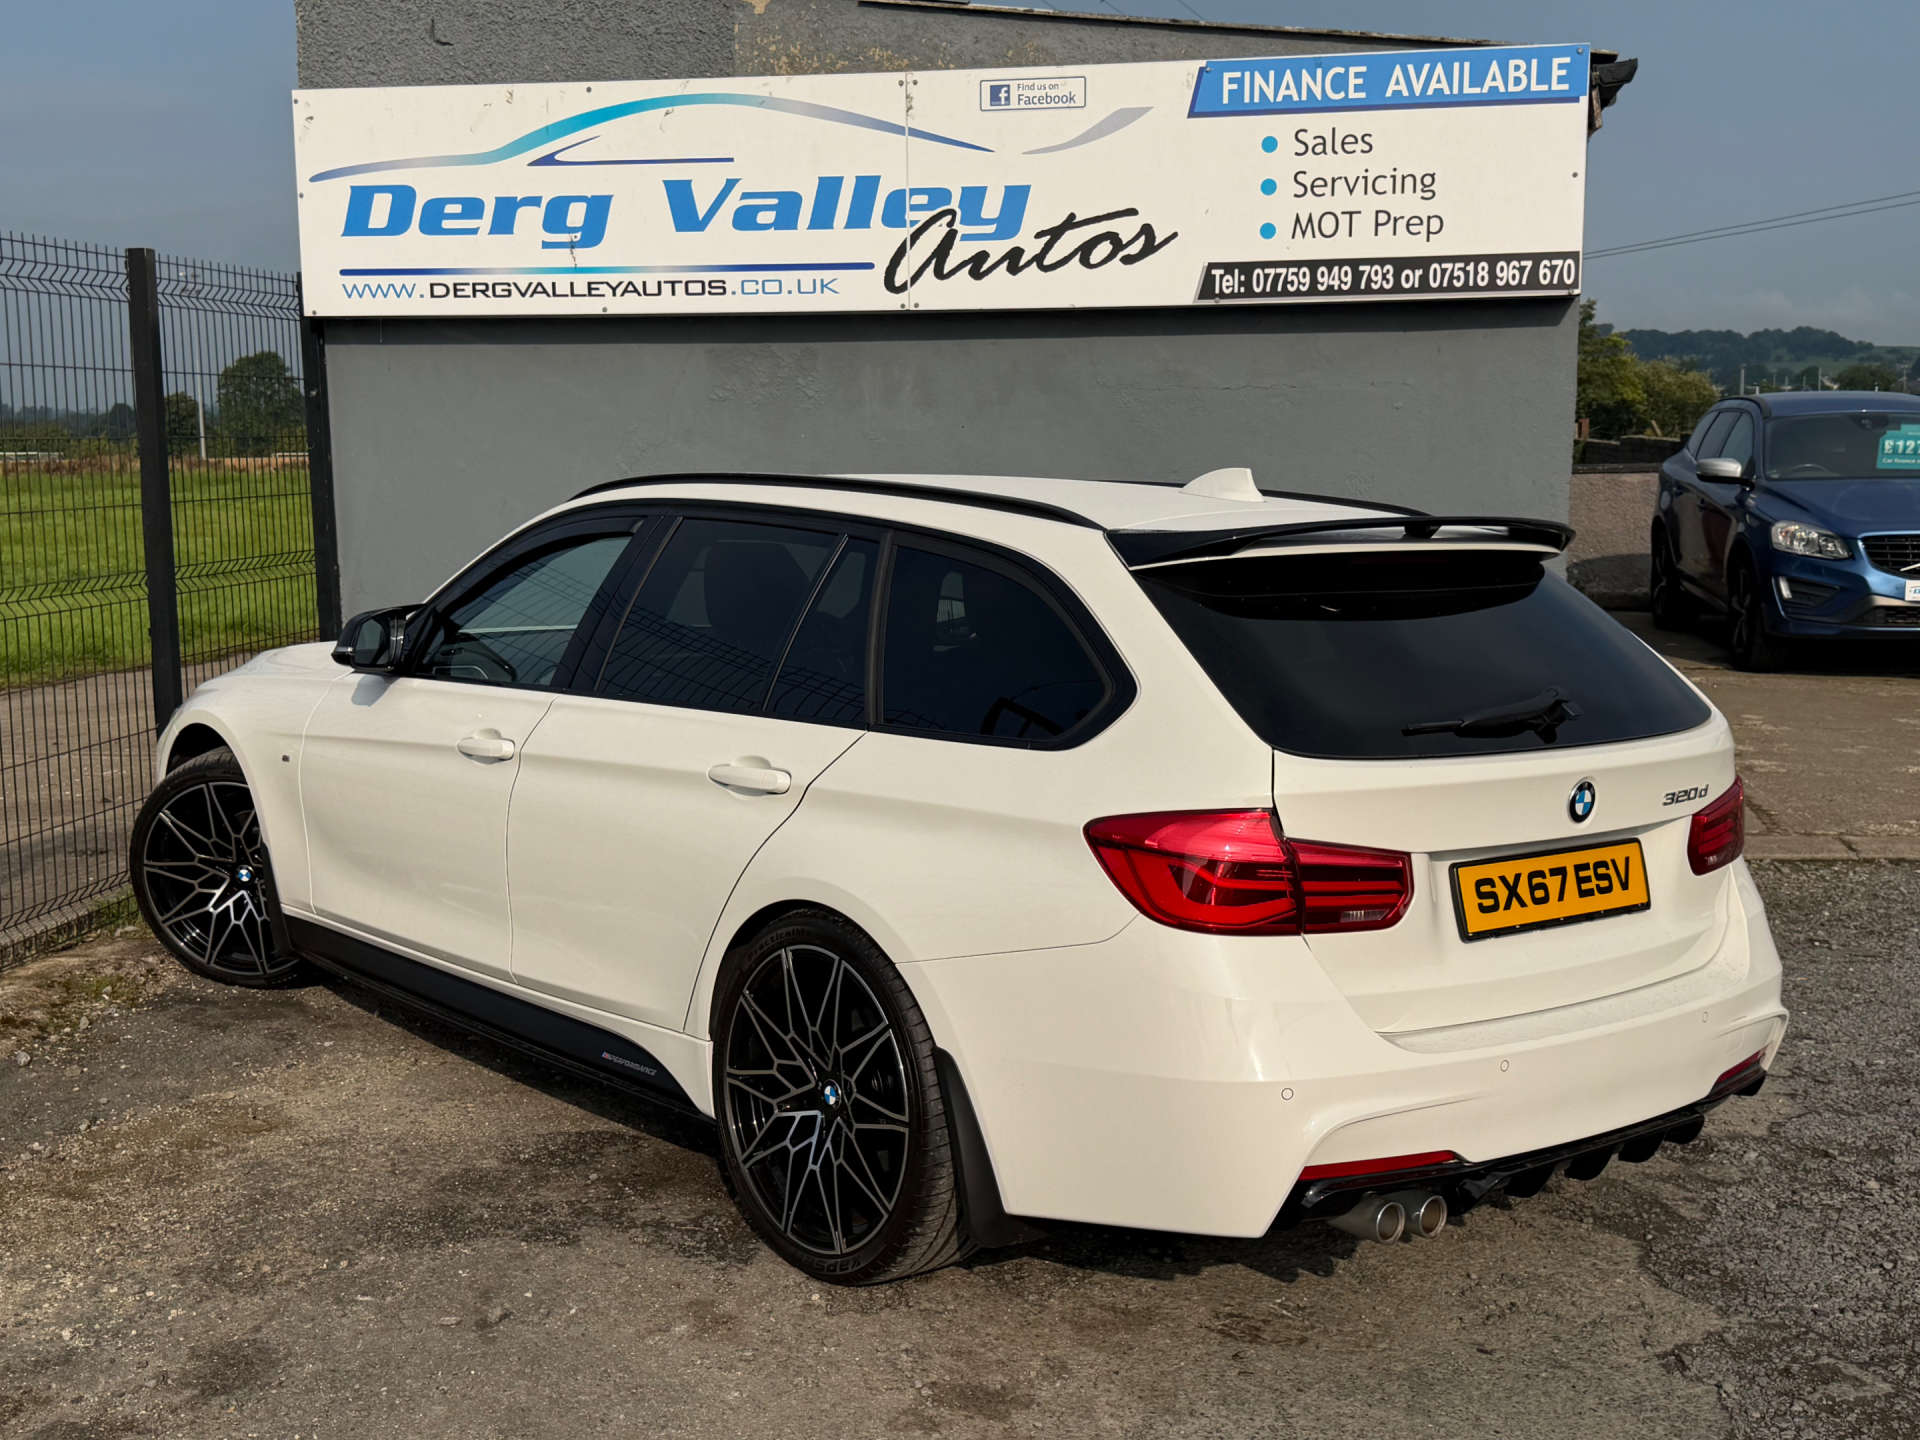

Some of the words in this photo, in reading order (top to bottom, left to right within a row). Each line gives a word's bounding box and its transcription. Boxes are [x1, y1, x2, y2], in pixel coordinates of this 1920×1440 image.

[1017, 83, 1035, 91] Find
[1222, 66, 1367, 104] FINANCE
[1385, 57, 1571, 98] AVAILABLE
[1017, 91, 1076, 105] Facebook
[1293, 127, 1374, 156] Sales
[1292, 168, 1437, 200] Servicing
[341, 185, 614, 249] Derg
[661, 175, 1032, 242] Valley
[1291, 211, 1362, 240] MOT
[1374, 210, 1445, 242] Prep
[883, 207, 1179, 295] Autos
[1211, 268, 1246, 295] Tel:
[1251, 267, 1311, 293] 07759
[1316, 265, 1353, 291] 949
[1358, 264, 1395, 290] 793
[1401, 265, 1423, 289] or
[1428, 261, 1490, 288] 07518
[1495, 260, 1533, 286] 967
[1538, 258, 1576, 285] 670
[1662, 783, 1710, 806] 320d
[1474, 866, 1568, 914] SX67
[1574, 855, 1631, 899] ESV
